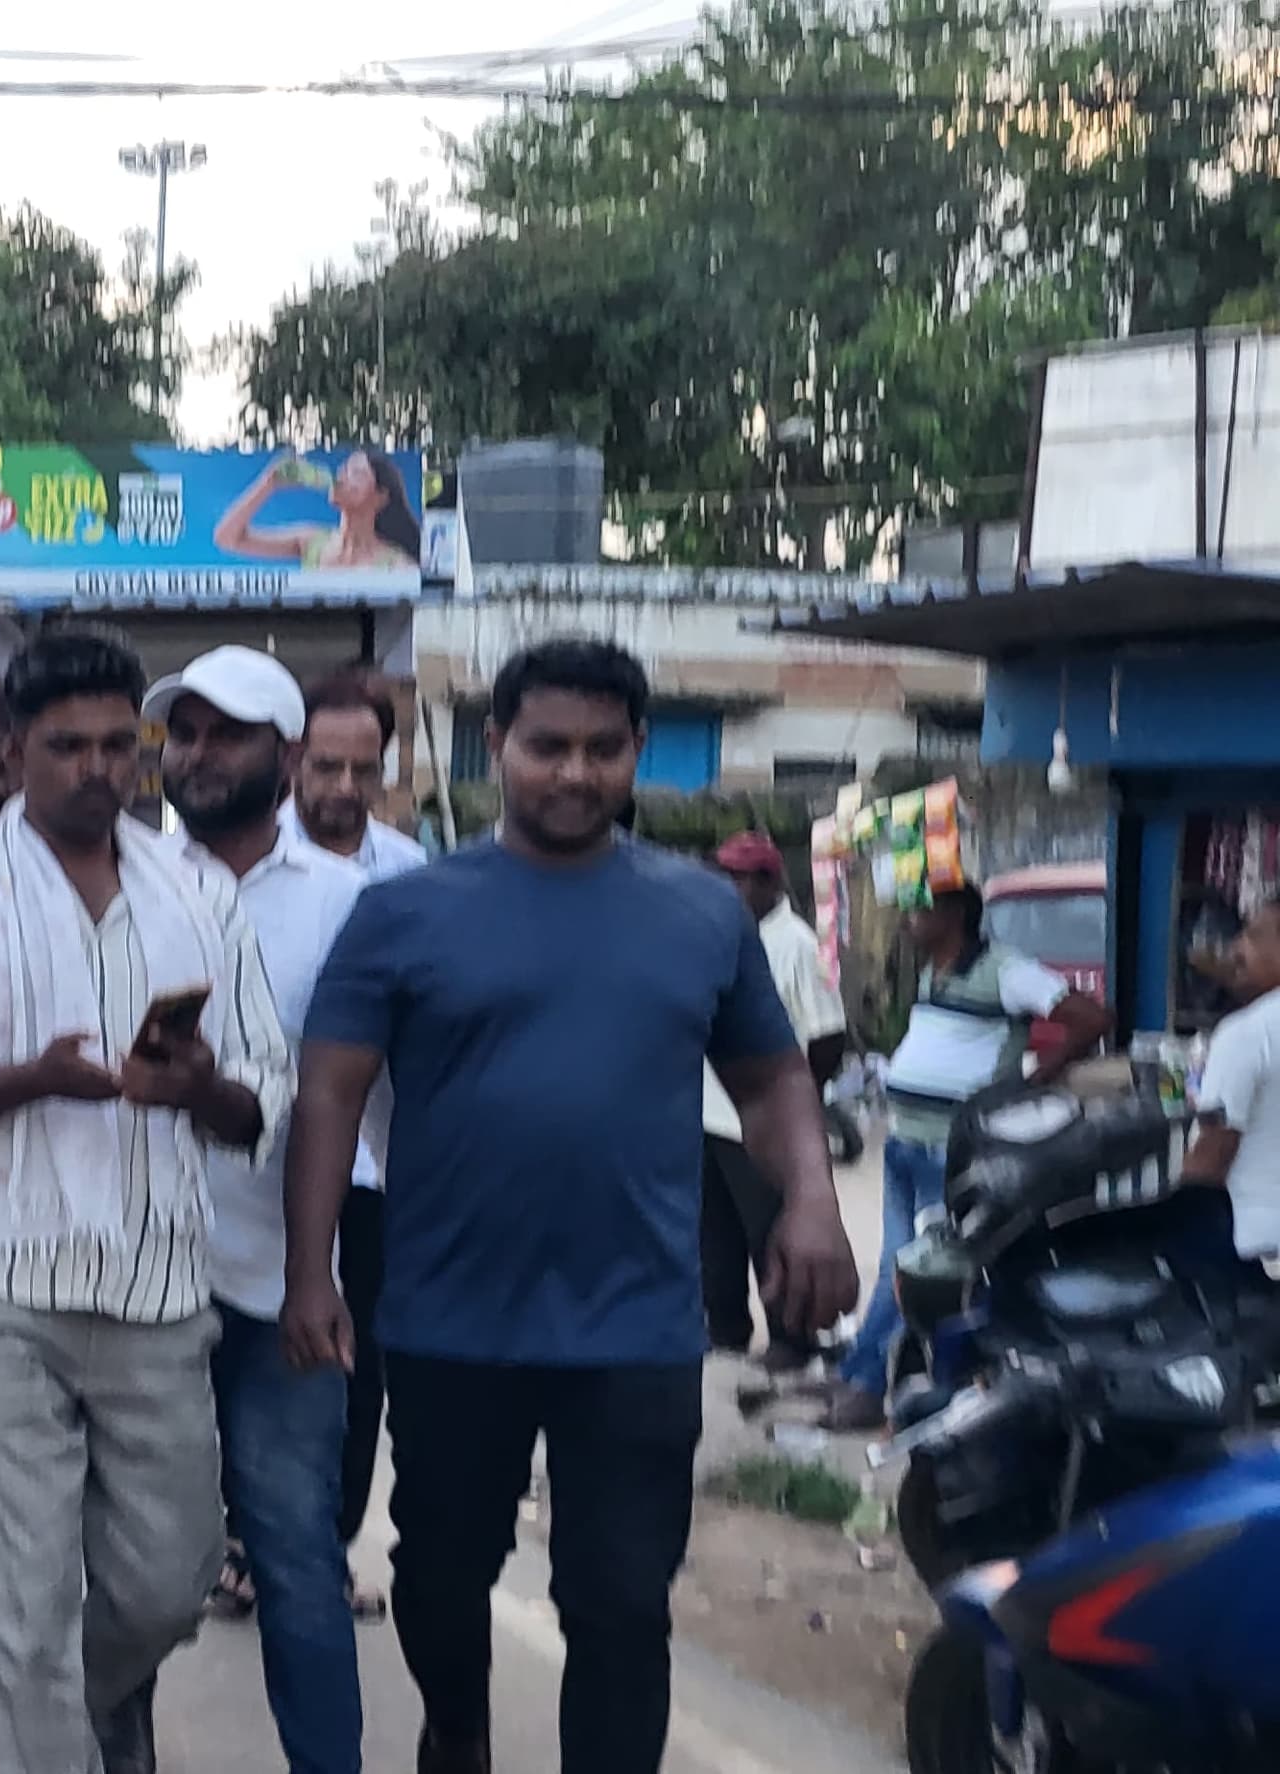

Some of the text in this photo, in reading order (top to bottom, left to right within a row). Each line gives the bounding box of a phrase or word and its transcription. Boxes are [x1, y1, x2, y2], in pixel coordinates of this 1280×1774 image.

[31, 472, 107, 514] EXTRA
[74, 570, 290, 597] CRYSTAL BETEL SHOP
